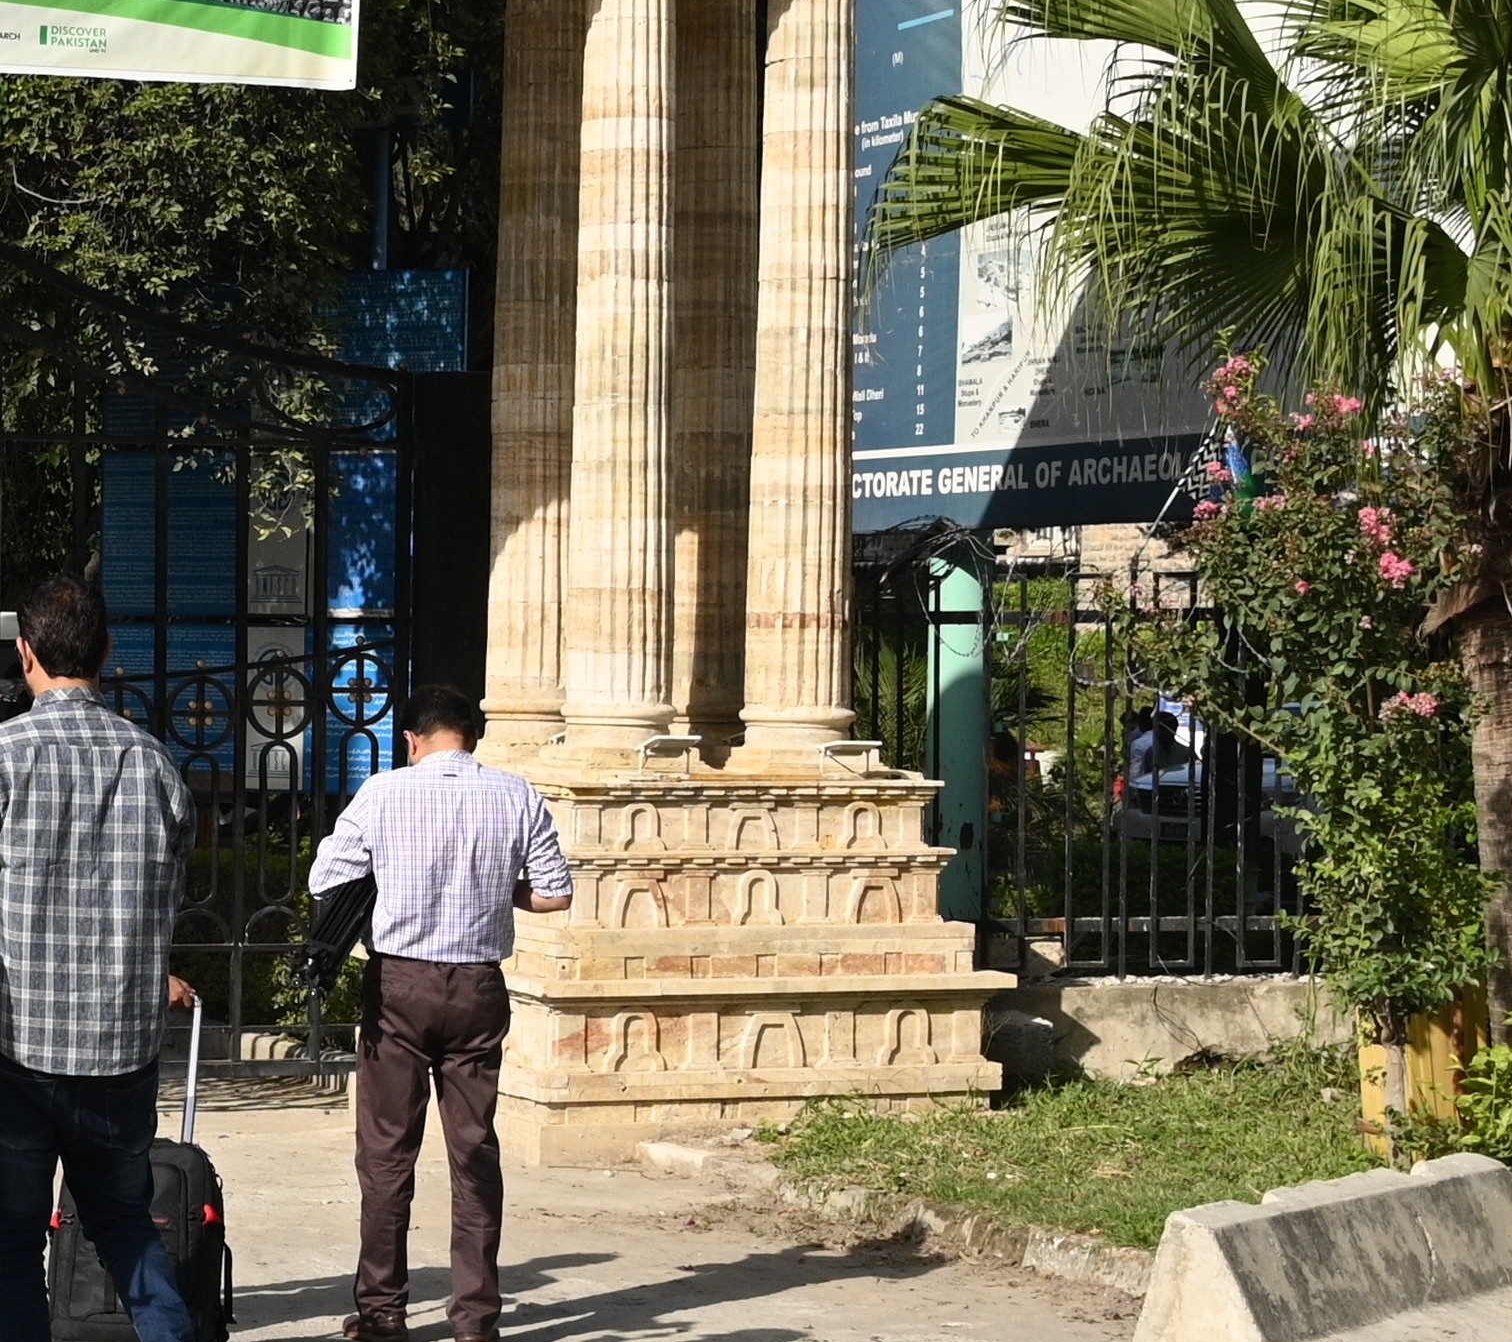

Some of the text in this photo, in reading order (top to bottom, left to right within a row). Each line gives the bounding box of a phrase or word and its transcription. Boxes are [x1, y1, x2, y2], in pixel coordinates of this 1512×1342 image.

[51, 25, 106, 37] DISCOVER
[51, 37, 107, 48] PAKISTAN
[861, 120, 879, 134] from
[881, 115, 902, 129] Taxila
[854, 164, 871, 177] ound
[920, 267, 925, 279] 5
[919, 286, 925, 298] 5
[918, 346, 923, 357] 7
[916, 365, 922, 377] 8
[917, 384, 924, 396] 11
[916, 404, 924, 416] 15
[915, 423, 924, 436] 22
[852, 449, 1188, 499] CTORATE GENERAL OF ARCHAEOL
